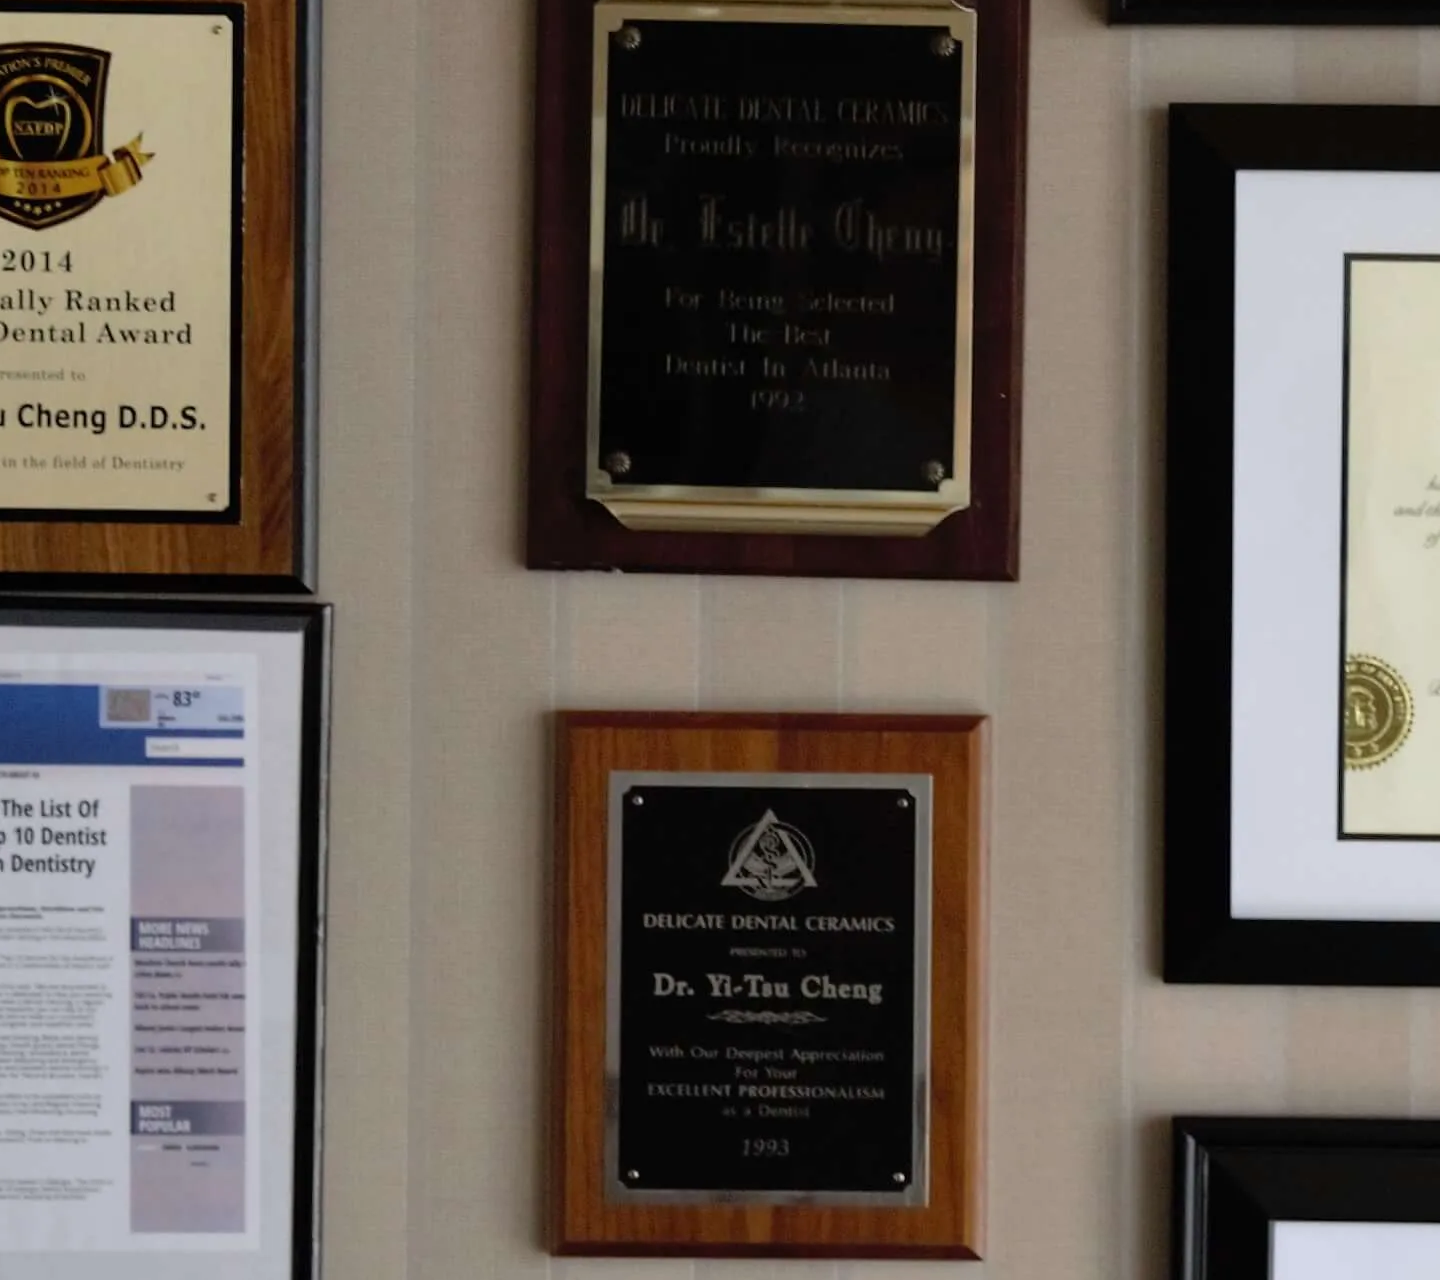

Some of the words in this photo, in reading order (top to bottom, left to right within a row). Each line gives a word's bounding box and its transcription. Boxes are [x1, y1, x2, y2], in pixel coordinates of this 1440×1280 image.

[739, 96, 825, 122] DENTAL
[1, 249, 74, 273] 2014
[65, 289, 177, 313] Ranked
[97, 324, 192, 345] Award
[71, 370, 86, 382] to
[18, 404, 106, 434] Cheng
[119, 406, 207, 430] D.D.S.
[2, 455, 16, 468] in
[22, 455, 46, 469] the
[53, 455, 86, 470] field
[91, 456, 105, 470] of
[112, 457, 185, 473] Dentistry
[0, 799, 34, 818] The
[40, 799, 72, 818] List
[78, 799, 100, 818] Of
[15, 827, 35, 845] 10
[41, 827, 107, 847] Dentist
[11, 854, 97, 879] Dentistry
[642, 913, 725, 930] DELICATE
[731, 915, 798, 931] DENTAL
[804, 916, 896, 933] CERAMICS
[653, 972, 695, 997] Dr.
[706, 973, 790, 998] Yi-Tsu
[800, 975, 883, 1005] Cheng
[649, 1044, 684, 1059] With
[690, 1045, 718, 1059] Our
[725, 1045, 784, 1063] Deepest
[791, 1047, 885, 1064] Appreciation
[733, 1065, 758, 1079] For
[764, 1066, 797, 1079] Your
[647, 1083, 731, 1097] EXCELLENT
[738, 1084, 885, 1100] PROFESSIONALISM
[742, 1138, 790, 1157] 1993
